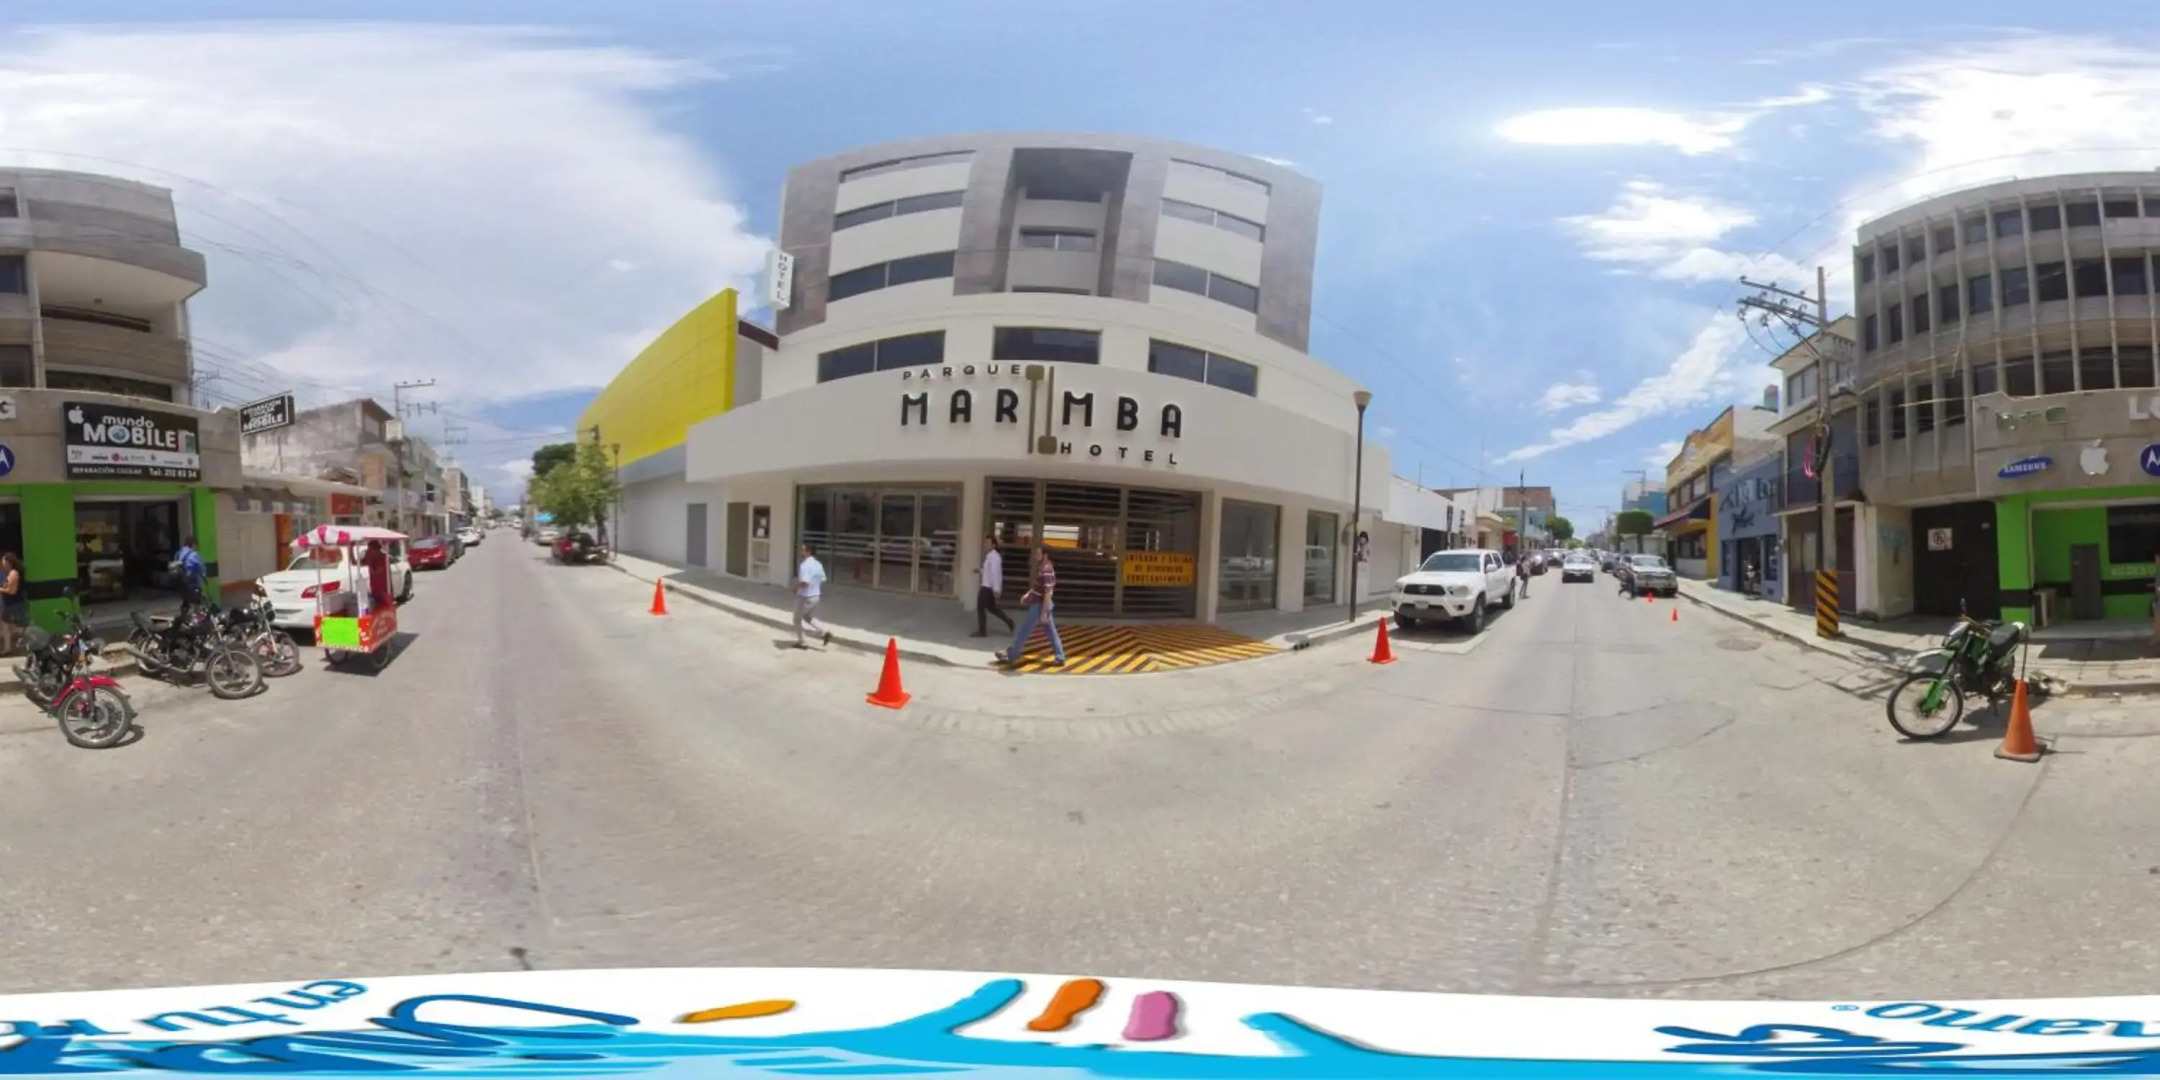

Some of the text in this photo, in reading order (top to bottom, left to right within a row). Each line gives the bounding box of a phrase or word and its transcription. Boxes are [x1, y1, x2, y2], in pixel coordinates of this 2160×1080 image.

[777, 254, 787, 301] HOTEL
[902, 364, 1020, 381] PARQUE
[102, 415, 154, 428] mundo
[1060, 441, 1178, 466] HOTEL
[2004, 462, 2046, 473] SAMSUNG
